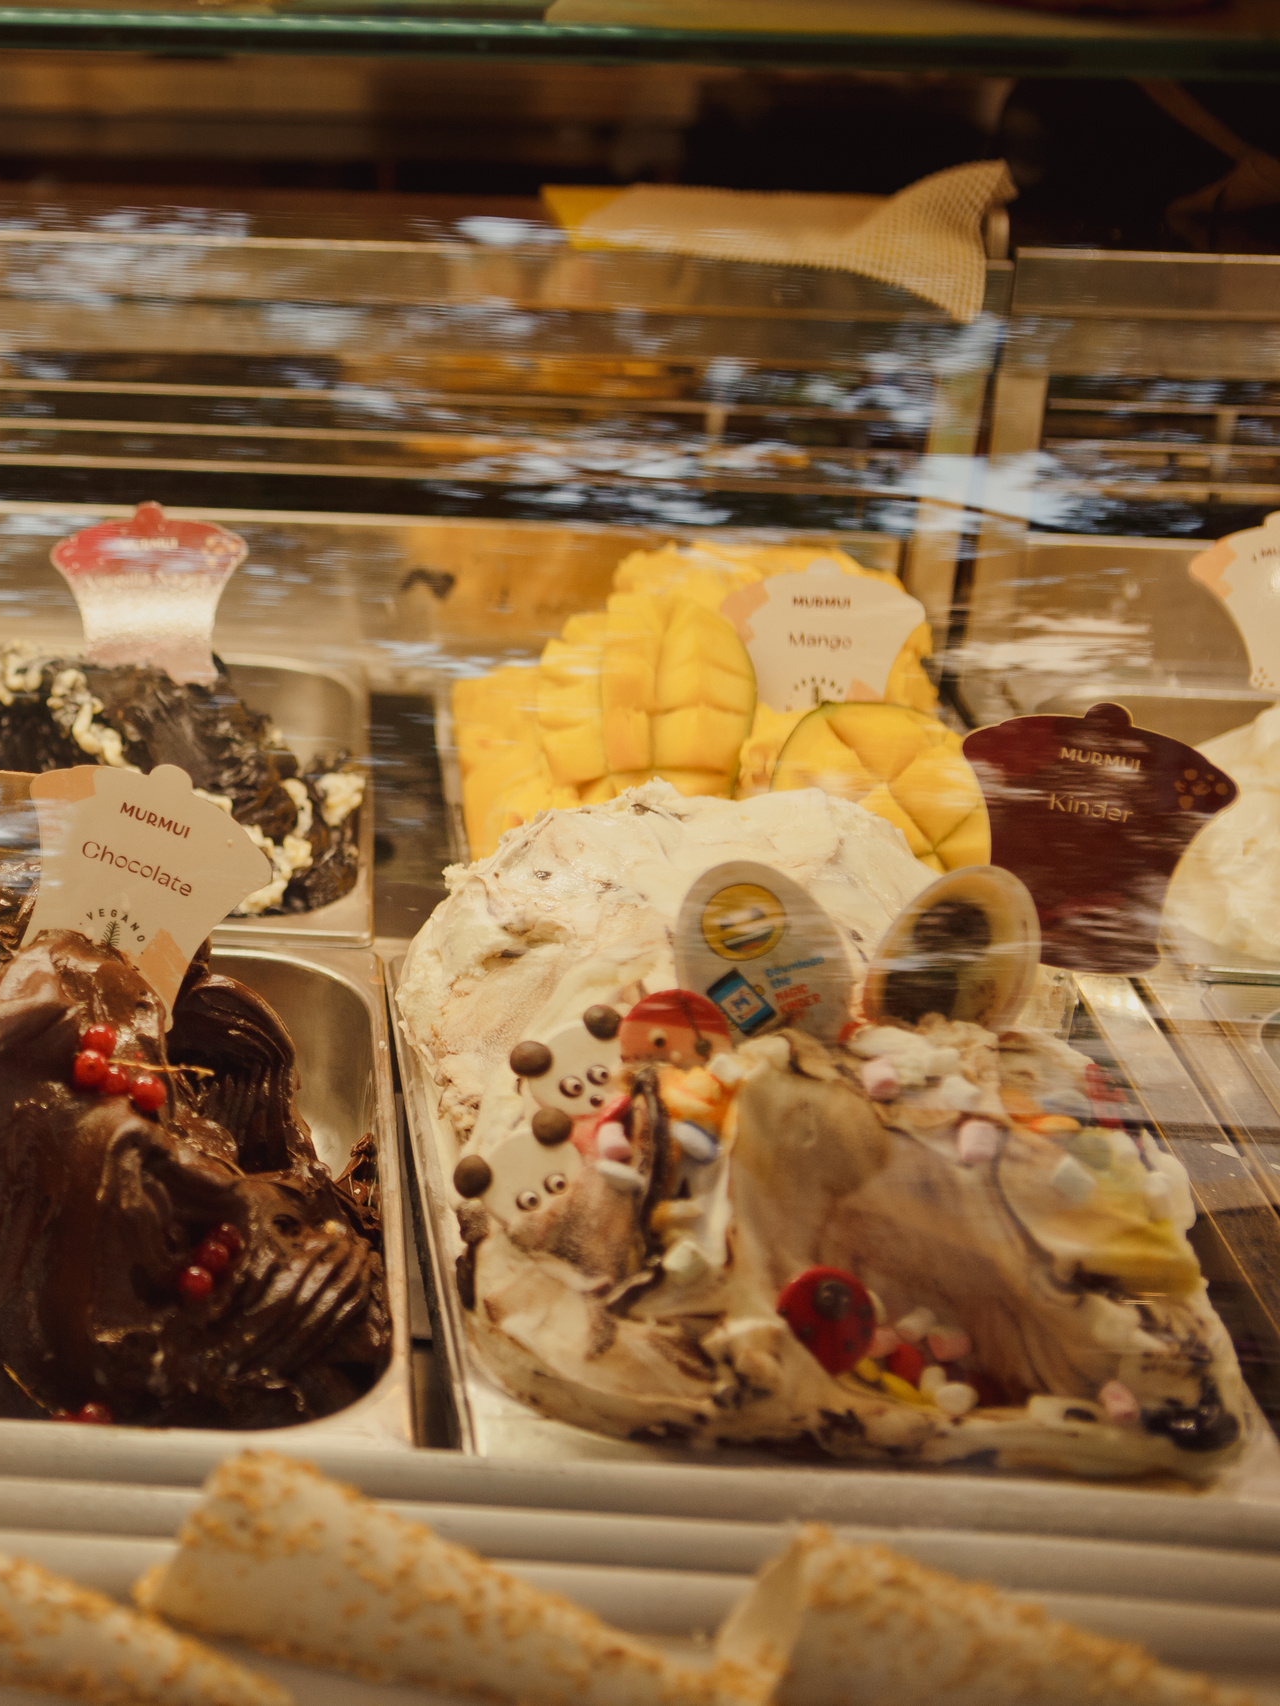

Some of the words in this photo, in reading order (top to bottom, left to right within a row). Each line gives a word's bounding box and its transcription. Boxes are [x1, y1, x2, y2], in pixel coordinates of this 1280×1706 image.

[792, 595, 851, 610] MURMUI
[789, 631, 853, 652] Mango
[1060, 746, 1141, 773] MURMUI
[119, 802, 191, 839] MURMUI
[1048, 793, 1134, 824] Kinder
[81, 840, 193, 898] Chocolate
[86, 908, 146, 943] VEGANO
